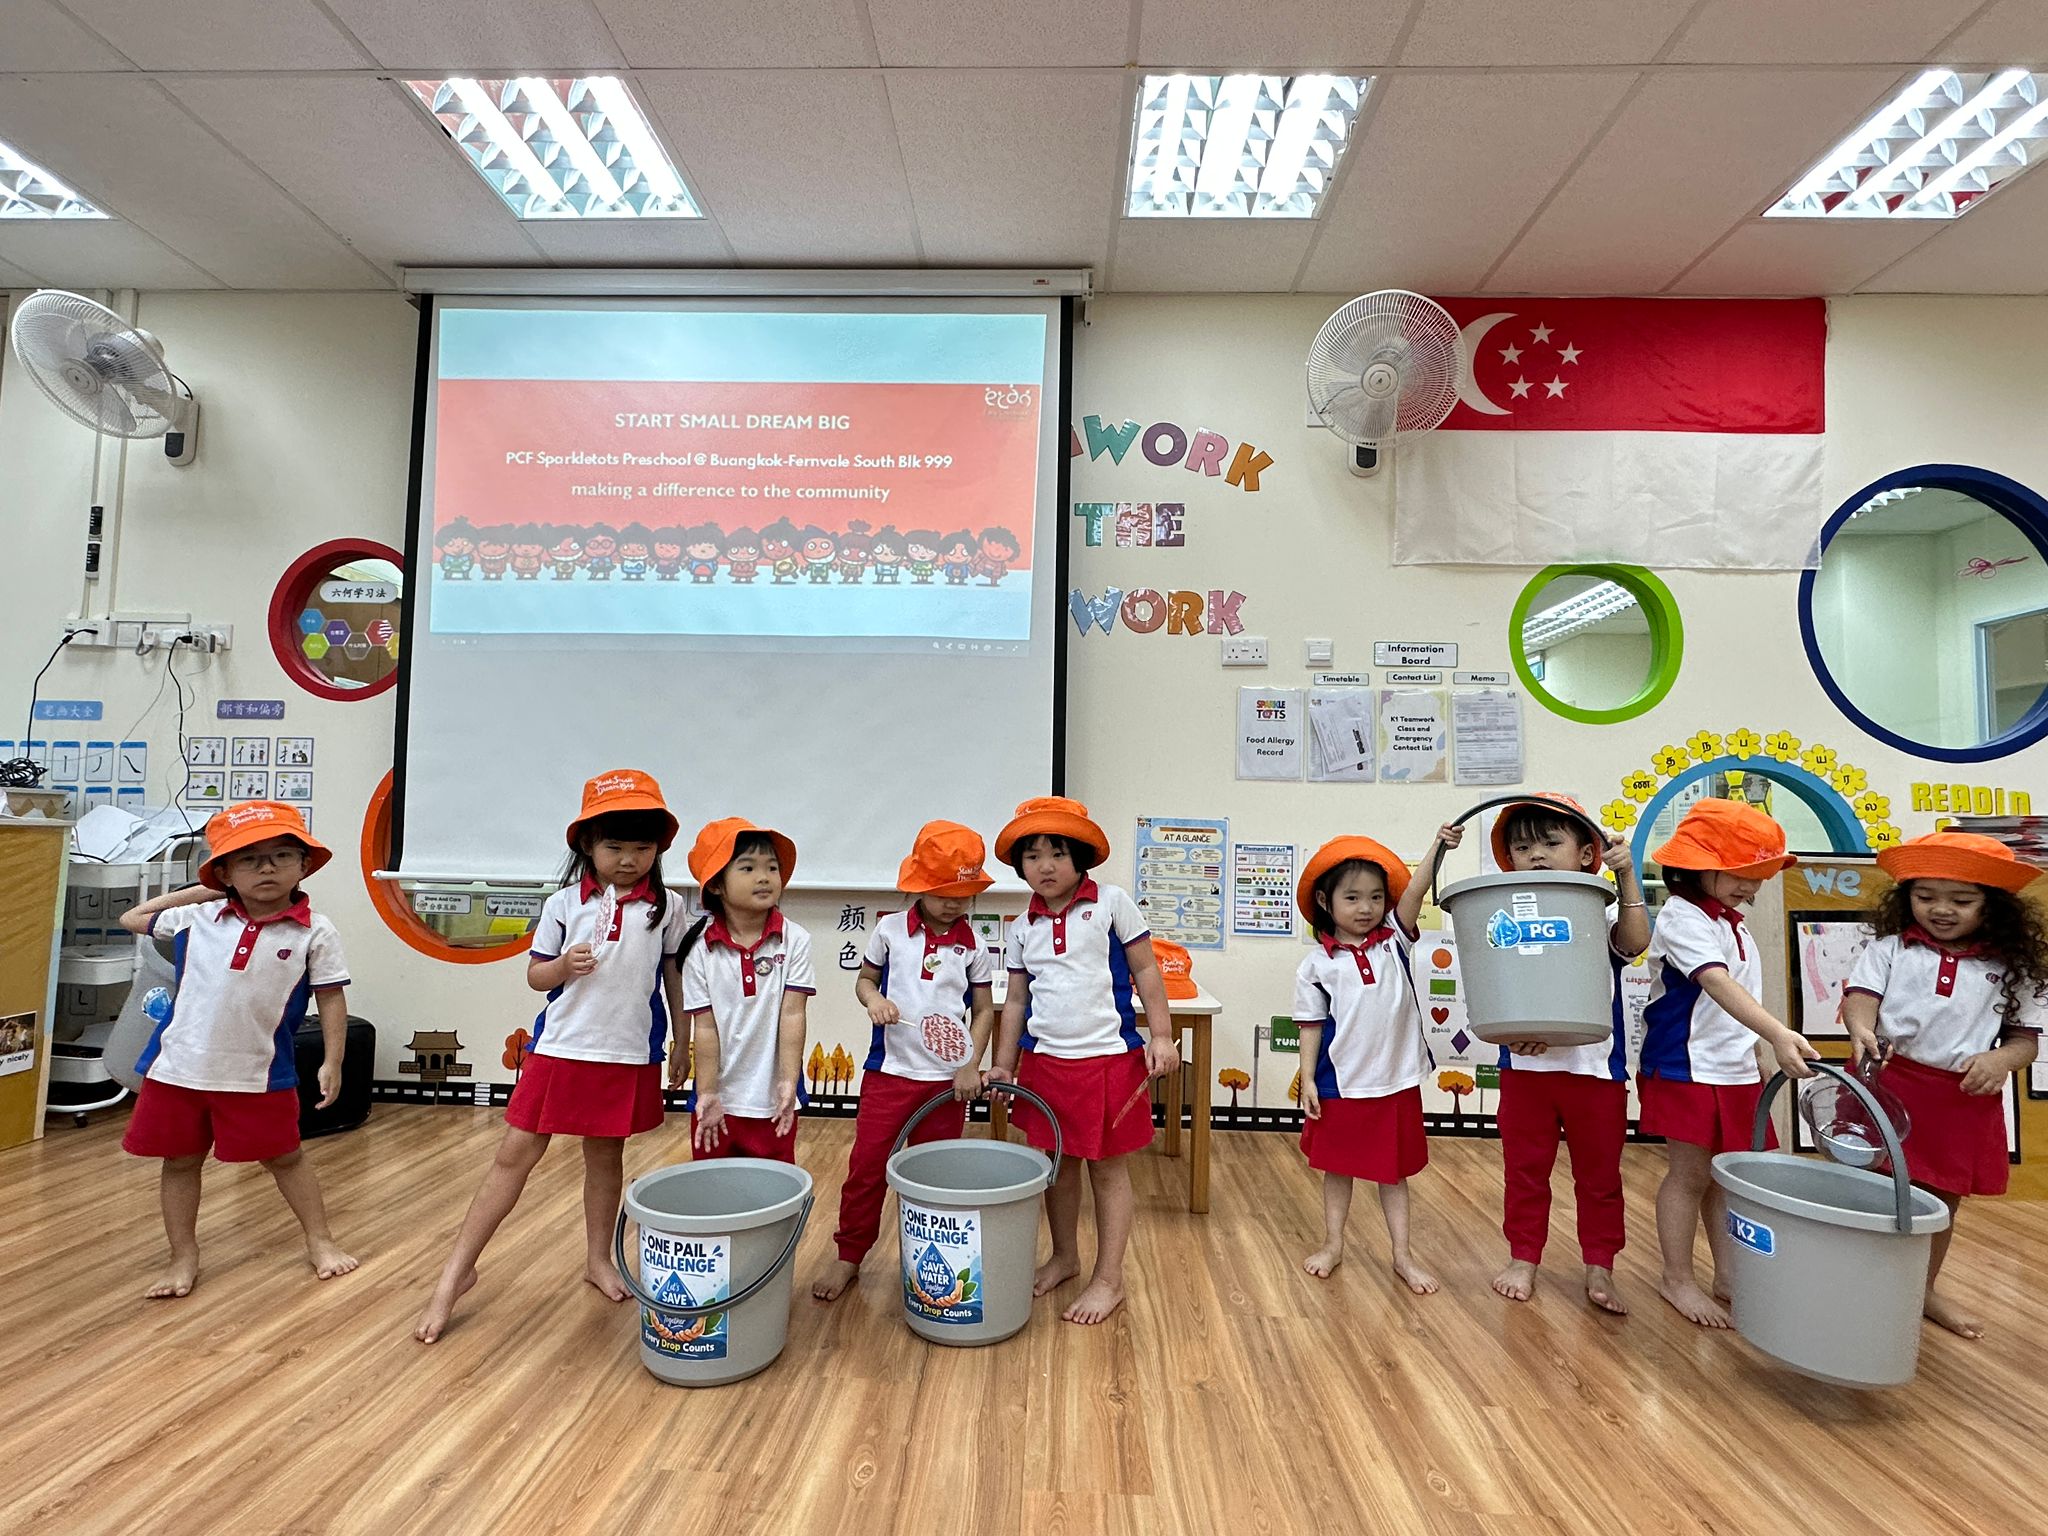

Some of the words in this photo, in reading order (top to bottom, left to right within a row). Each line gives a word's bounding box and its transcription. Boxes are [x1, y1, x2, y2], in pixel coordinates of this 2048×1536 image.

[615, 413, 674, 428] START
[680, 414, 740, 429] SMALL
[747, 415, 812, 429] DREAM
[818, 415, 850, 430] BIG
[506, 452, 534, 464] PCF
[536, 451, 619, 468] Sparkletots
[623, 452, 691, 466] Preschool
[694, 453, 707, 466] @
[710, 453, 849, 470] Buangkok-Fernvale
[854, 454, 895, 468] South
[899, 455, 921, 468] Blk
[925, 455, 952, 468] 999
[1071, 415, 1274, 492] WORK
[571, 482, 632, 500] making
[637, 485, 647, 496] a
[652, 483, 735, 497] difference
[741, 485, 758, 498] to
[764, 484, 791, 498] the
[796, 486, 890, 502] community
[1074, 502, 1185, 547] THE
[331, 588, 386, 598] 六何学习法
[1069, 586, 1246, 637] WORK
[1388, 644, 1444, 653] Information
[1401, 657, 1431, 665] Board
[1323, 675, 1360, 683] Timetable
[220, 703, 283, 716] 部首和偏旁
[1256, 700, 1286, 709] SPARKLE
[1246, 736, 1265, 744] Food
[1267, 737, 1295, 746] Allergy
[1395, 735, 1433, 743] Emergency
[1176, 834, 1181, 842] A
[1182, 835, 1211, 843] GLANCE
[1529, 923, 1556, 938] PG
[7, 1053, 29, 1063] nicely
[907, 1209, 927, 1227] ONE
[931, 1215, 960, 1231] PAIL
[904, 1221, 968, 1245] CHALLENGE
[1736, 1219, 1756, 1243] K2
[647, 1235, 670, 1254] ONE
[674, 1242, 707, 1258] PAIL
[644, 1248, 716, 1273] CHALLENGE
[922, 1261, 945, 1274] SAVE
[920, 1271, 950, 1286] WATER
[666, 1280, 680, 1292] Let's
[924, 1282, 945, 1293] Together
[662, 1291, 687, 1306] SAVE
[923, 1306, 942, 1316] Drop
[943, 1308, 972, 1318] Counts
[663, 1314, 686, 1328] Together
[661, 1339, 681, 1353] Drop
[682, 1343, 715, 1352] Counts
